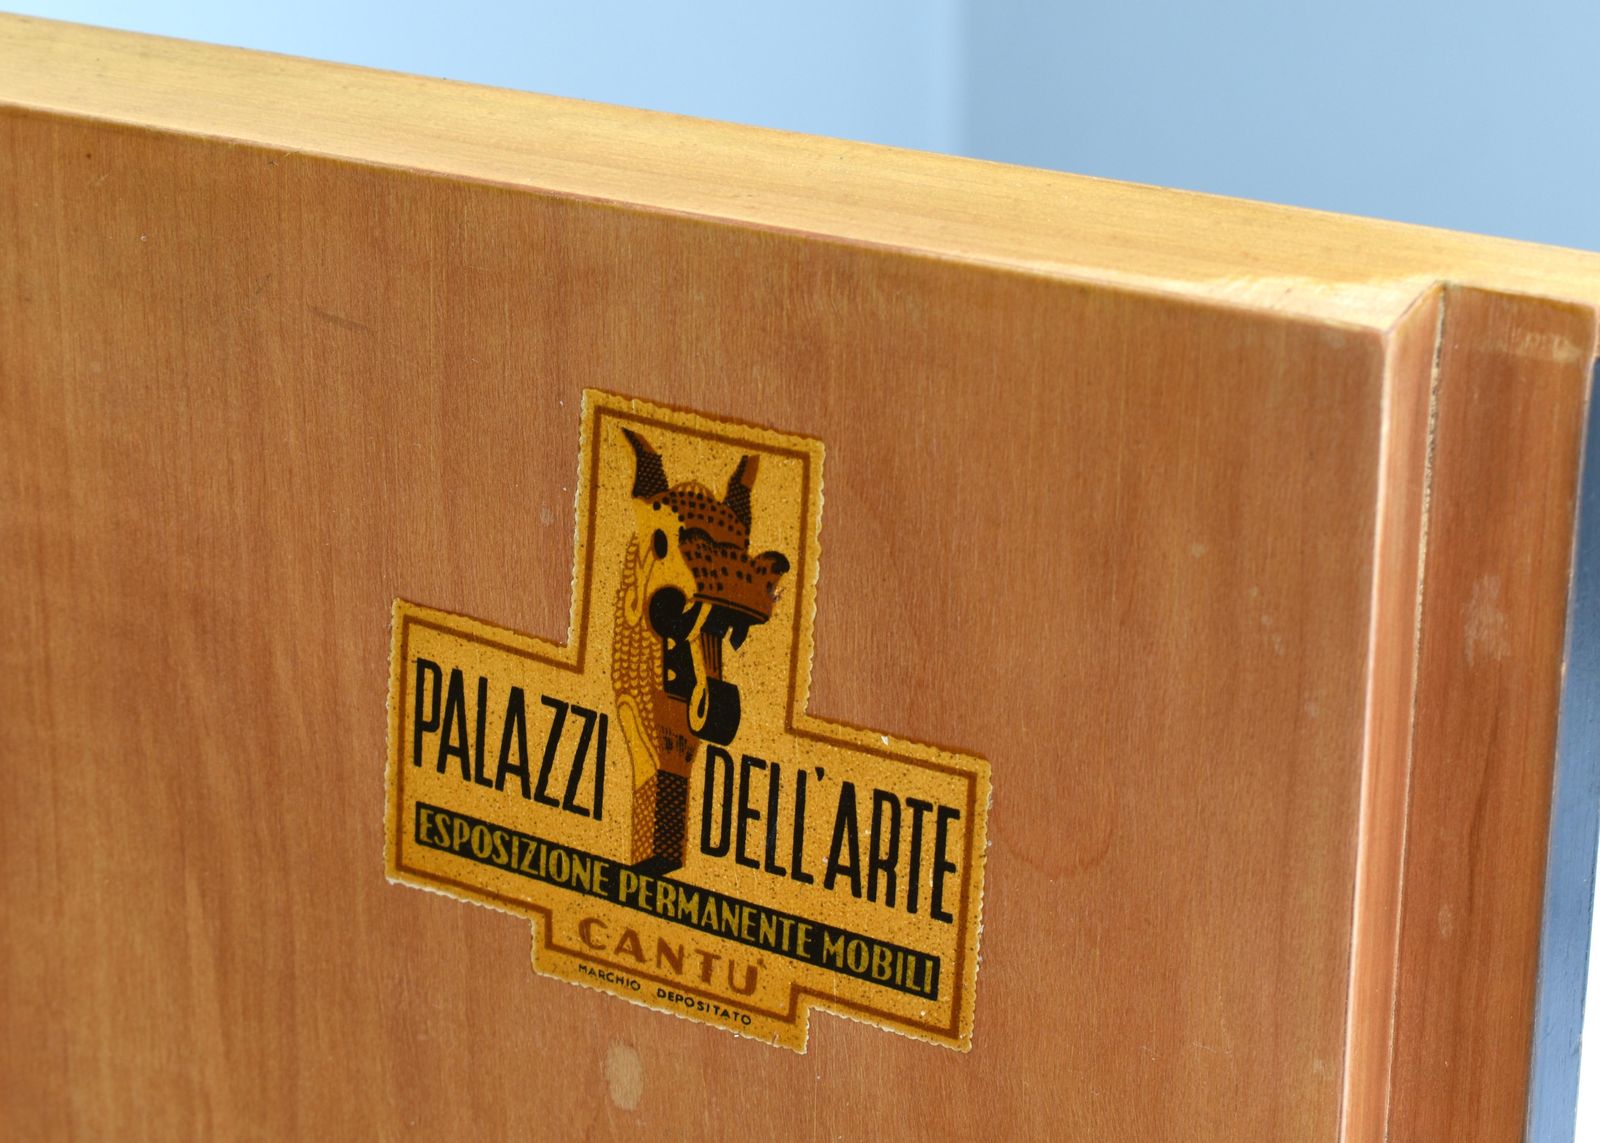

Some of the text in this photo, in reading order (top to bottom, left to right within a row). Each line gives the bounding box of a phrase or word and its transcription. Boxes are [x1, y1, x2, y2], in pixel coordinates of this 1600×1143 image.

[413, 657, 960, 924] PALAZZI DELL'ARTE
[419, 808, 933, 995] ESPOSIZIONE PERMANENTE MOBILI
[578, 963, 751, 1026] MARCHIO DEPOSITATO
